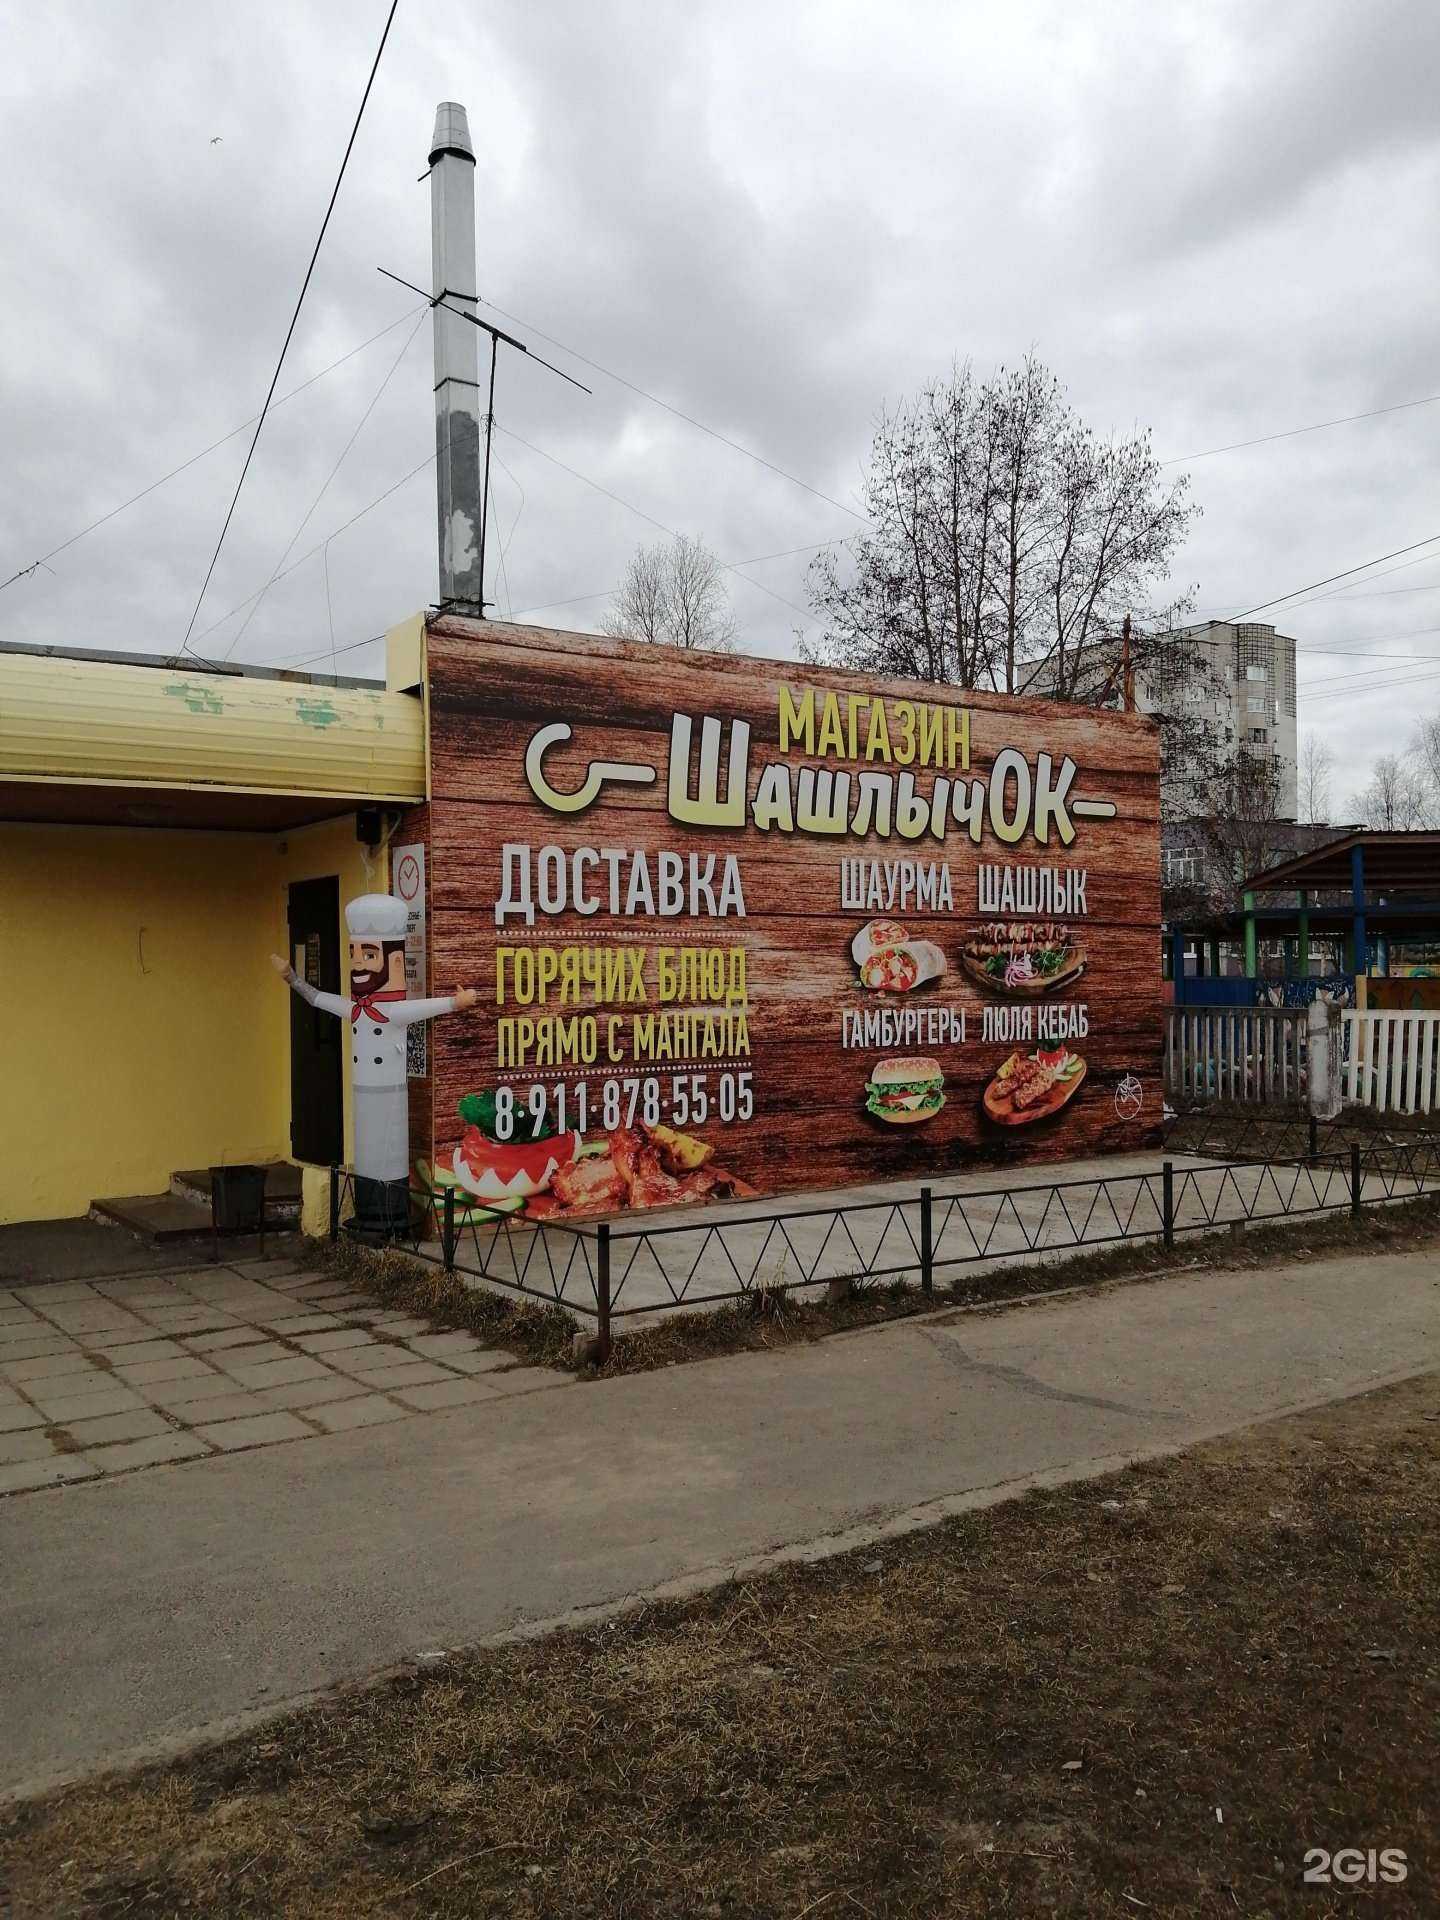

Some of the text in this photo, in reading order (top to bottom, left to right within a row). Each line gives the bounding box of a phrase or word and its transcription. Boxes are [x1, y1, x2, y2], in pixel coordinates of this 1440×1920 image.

[779, 686, 970, 769] МАГАЗИН
[494, 843, 747, 925] ДОСТАВКА
[841, 857, 954, 911] ШАУРМА
[978, 864, 1088, 913] ШАШЛЫК
[496, 947, 748, 1009] ГОРЯЧИХ БЛЮД
[497, 1011, 751, 1068] ПРЯМО С МАНГАЛА
[842, 1007, 966, 1049] ГАМБУРГЕРЫ
[981, 1004, 1089, 1042] ЛЮЛЯ КЕБАБ
